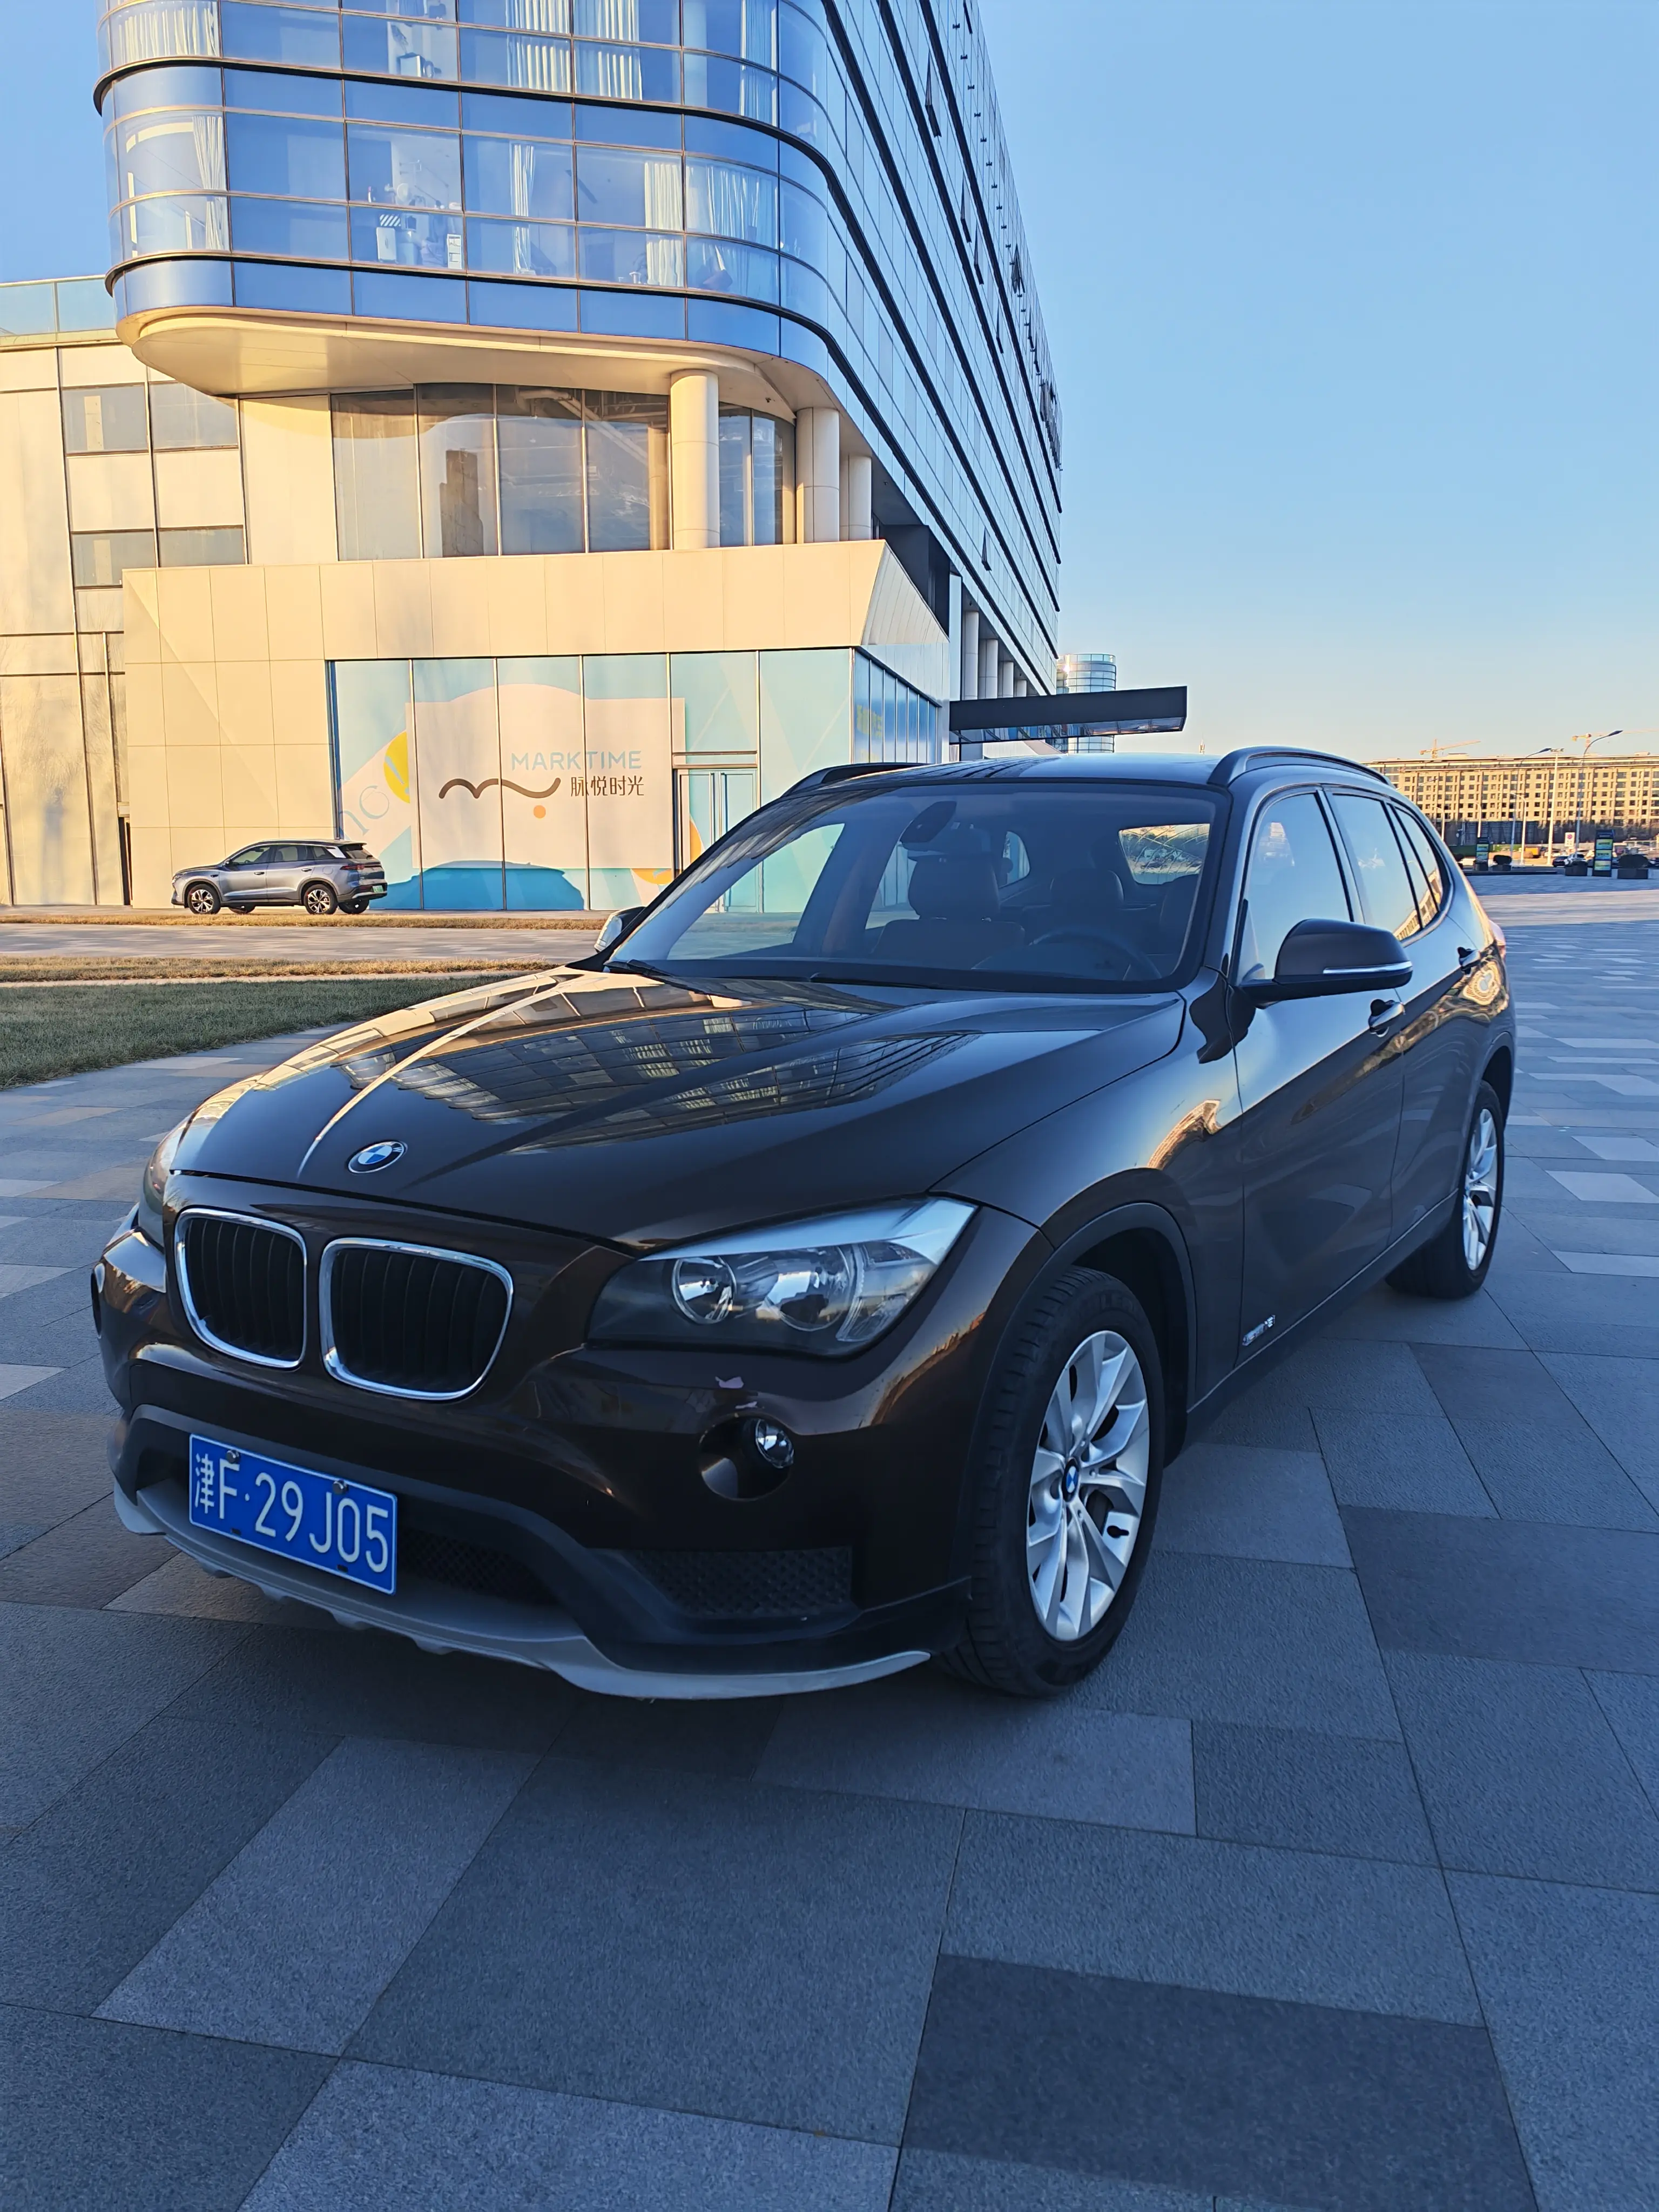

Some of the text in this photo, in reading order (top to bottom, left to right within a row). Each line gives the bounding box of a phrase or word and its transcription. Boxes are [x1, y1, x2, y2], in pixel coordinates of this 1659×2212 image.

[511, 751, 642, 771] MARKTIME
[571, 775, 644, 797] 脉悦时光
